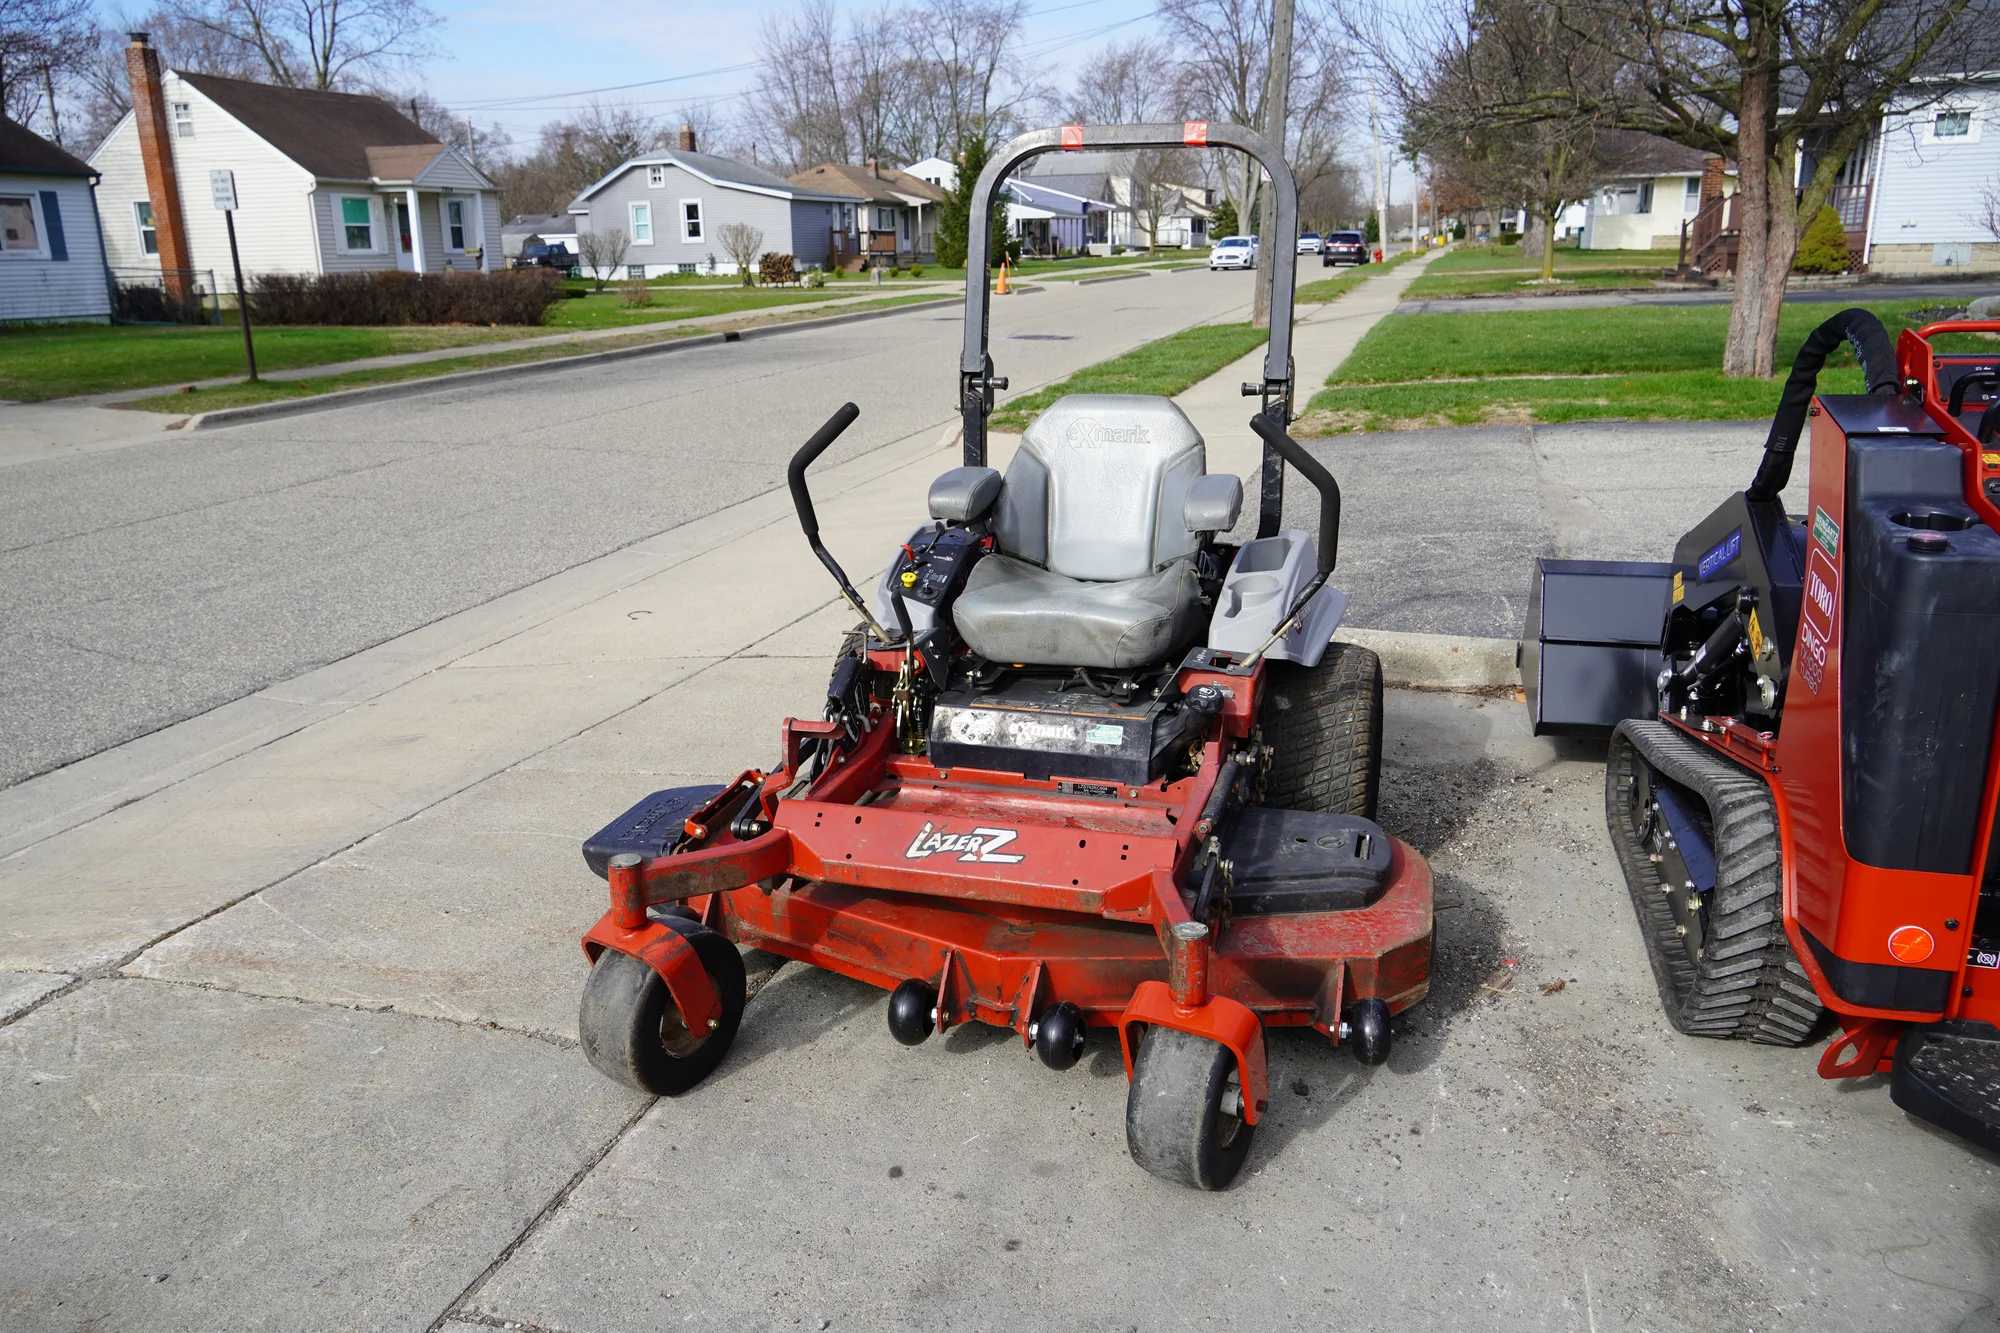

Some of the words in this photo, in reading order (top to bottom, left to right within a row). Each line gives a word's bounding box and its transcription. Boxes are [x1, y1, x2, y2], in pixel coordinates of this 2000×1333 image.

[1698, 546, 1727, 576] VERTICAL
[1726, 534, 1740, 557] LIFT
[1809, 571, 1833, 617] TORO
[1801, 622, 1826, 667] DINGO
[1800, 662, 1819, 695] TURBO
[904, 820, 985, 859] LAZER
[956, 826, 1026, 865] Z
